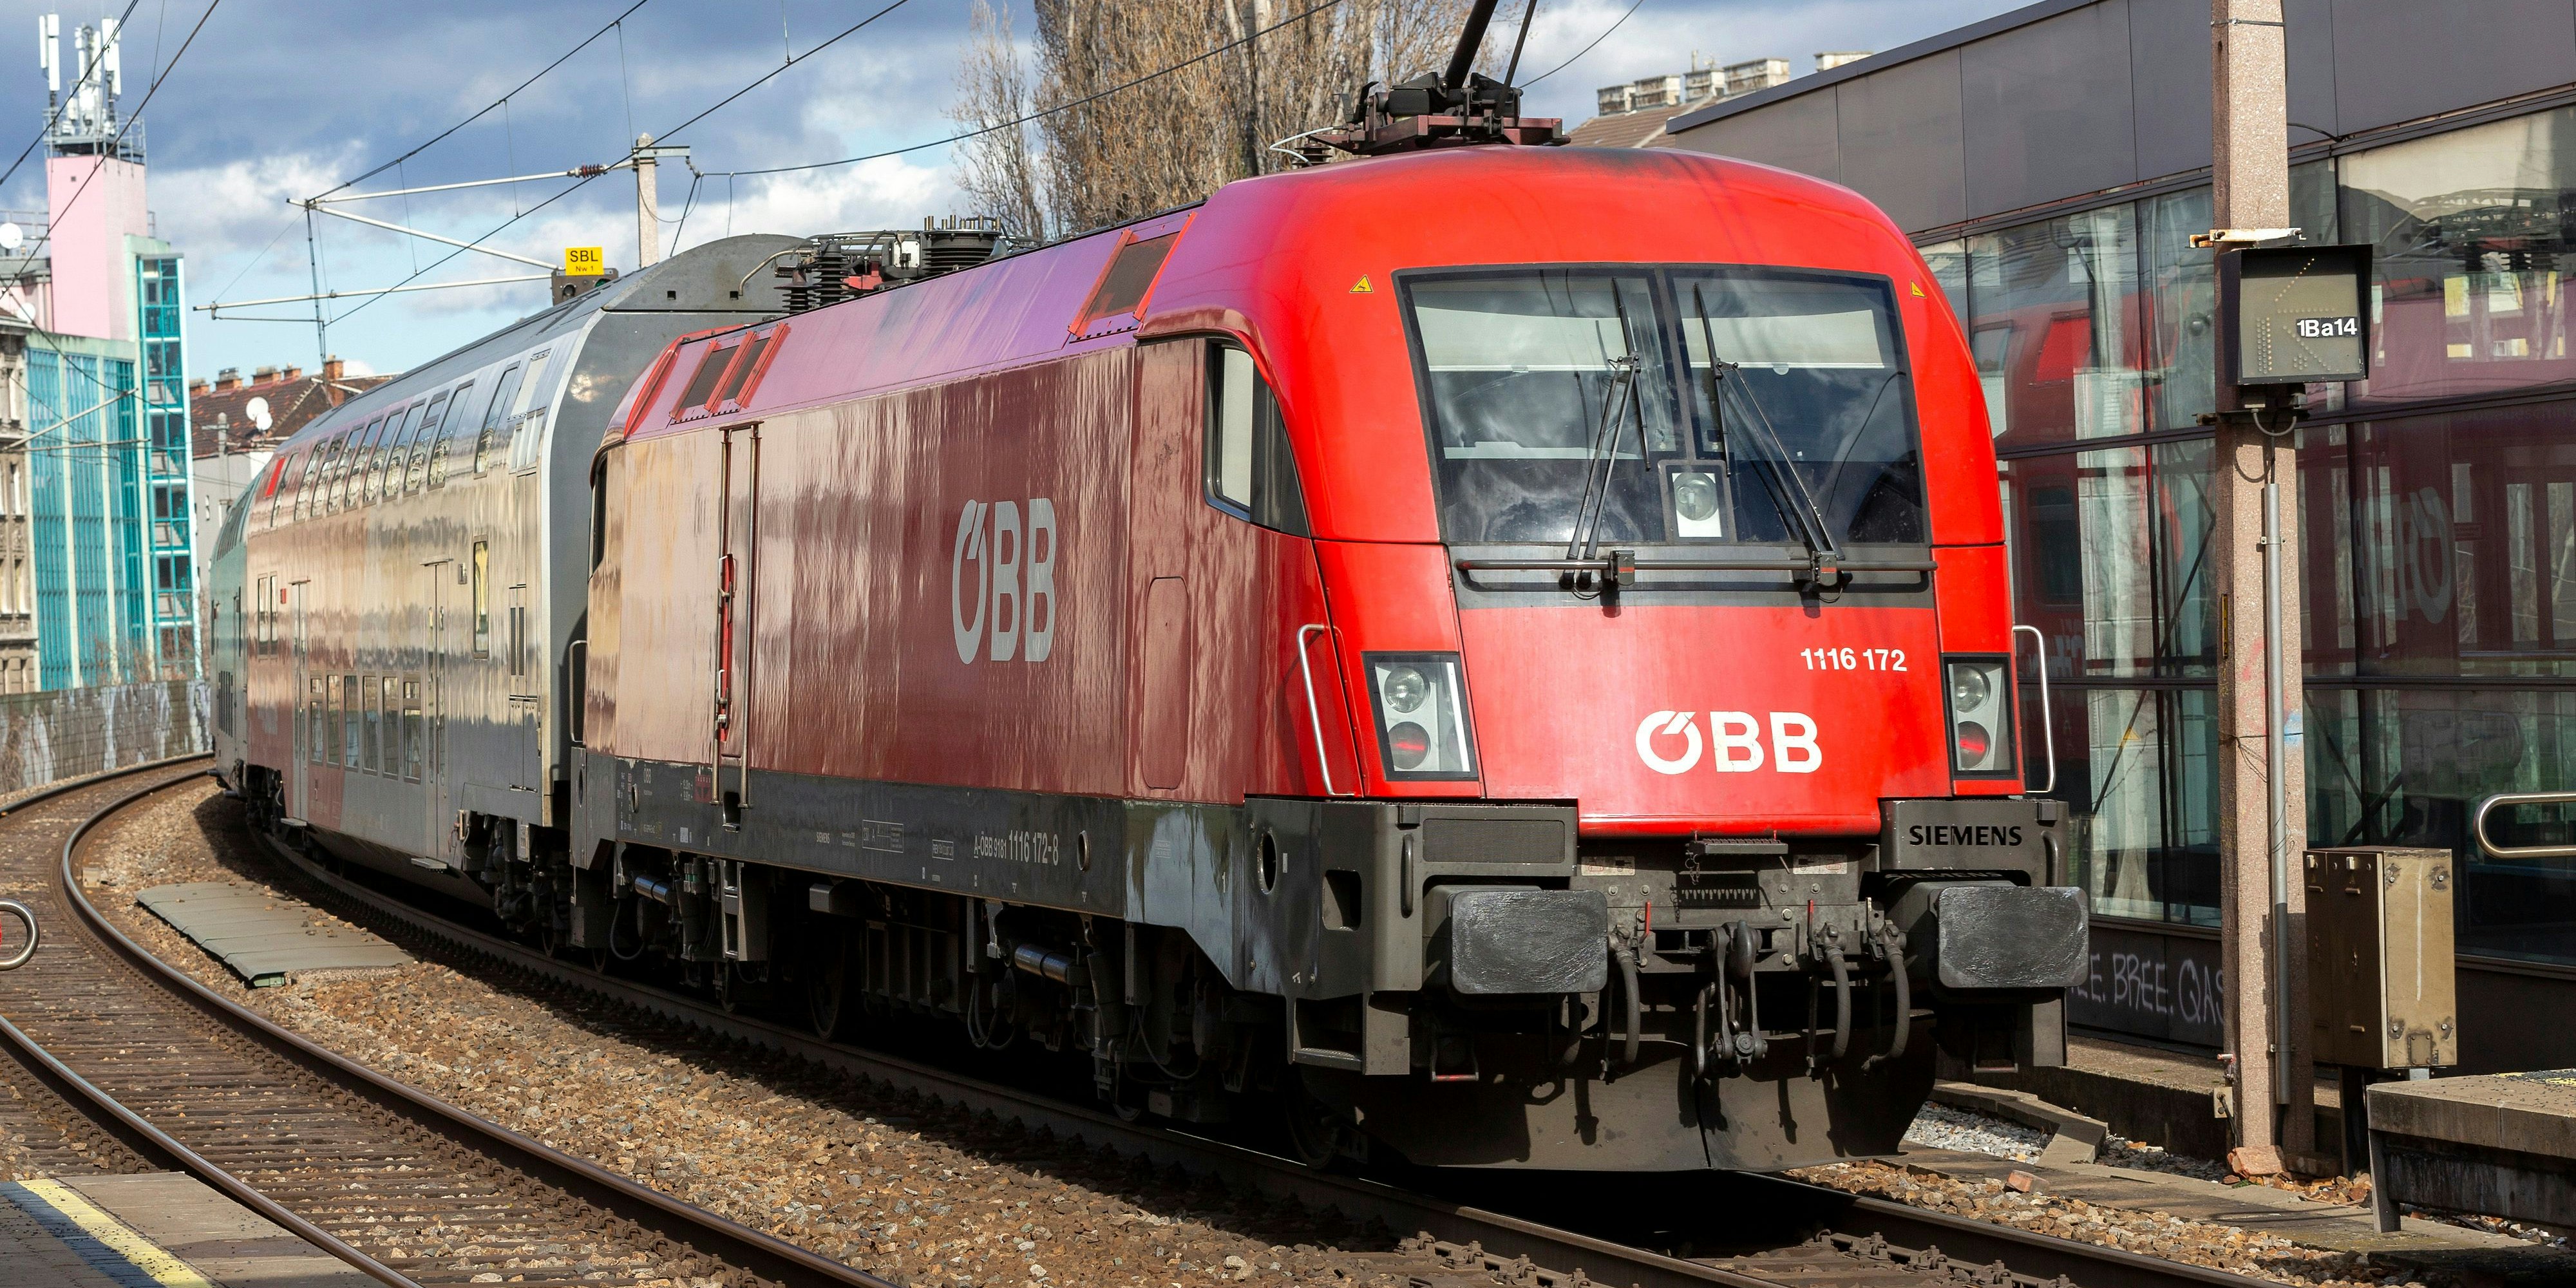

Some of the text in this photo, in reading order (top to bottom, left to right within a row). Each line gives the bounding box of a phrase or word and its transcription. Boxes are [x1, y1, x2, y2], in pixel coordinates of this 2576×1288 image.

[570, 250, 598, 262] SBL
[2297, 317, 2358, 337] 1Ba14
[952, 498, 1057, 665] ÖBB
[1800, 647, 1908, 672] 1116 172
[1635, 710, 1823, 775] ÖBB
[816, 831, 830, 844] SIEMENS
[1909, 825, 2023, 846] SIEMENS
[994, 837, 1007, 859] 9181
[1009, 829, 1030, 863] 1116
[1033, 832, 1059, 866] 172-8
